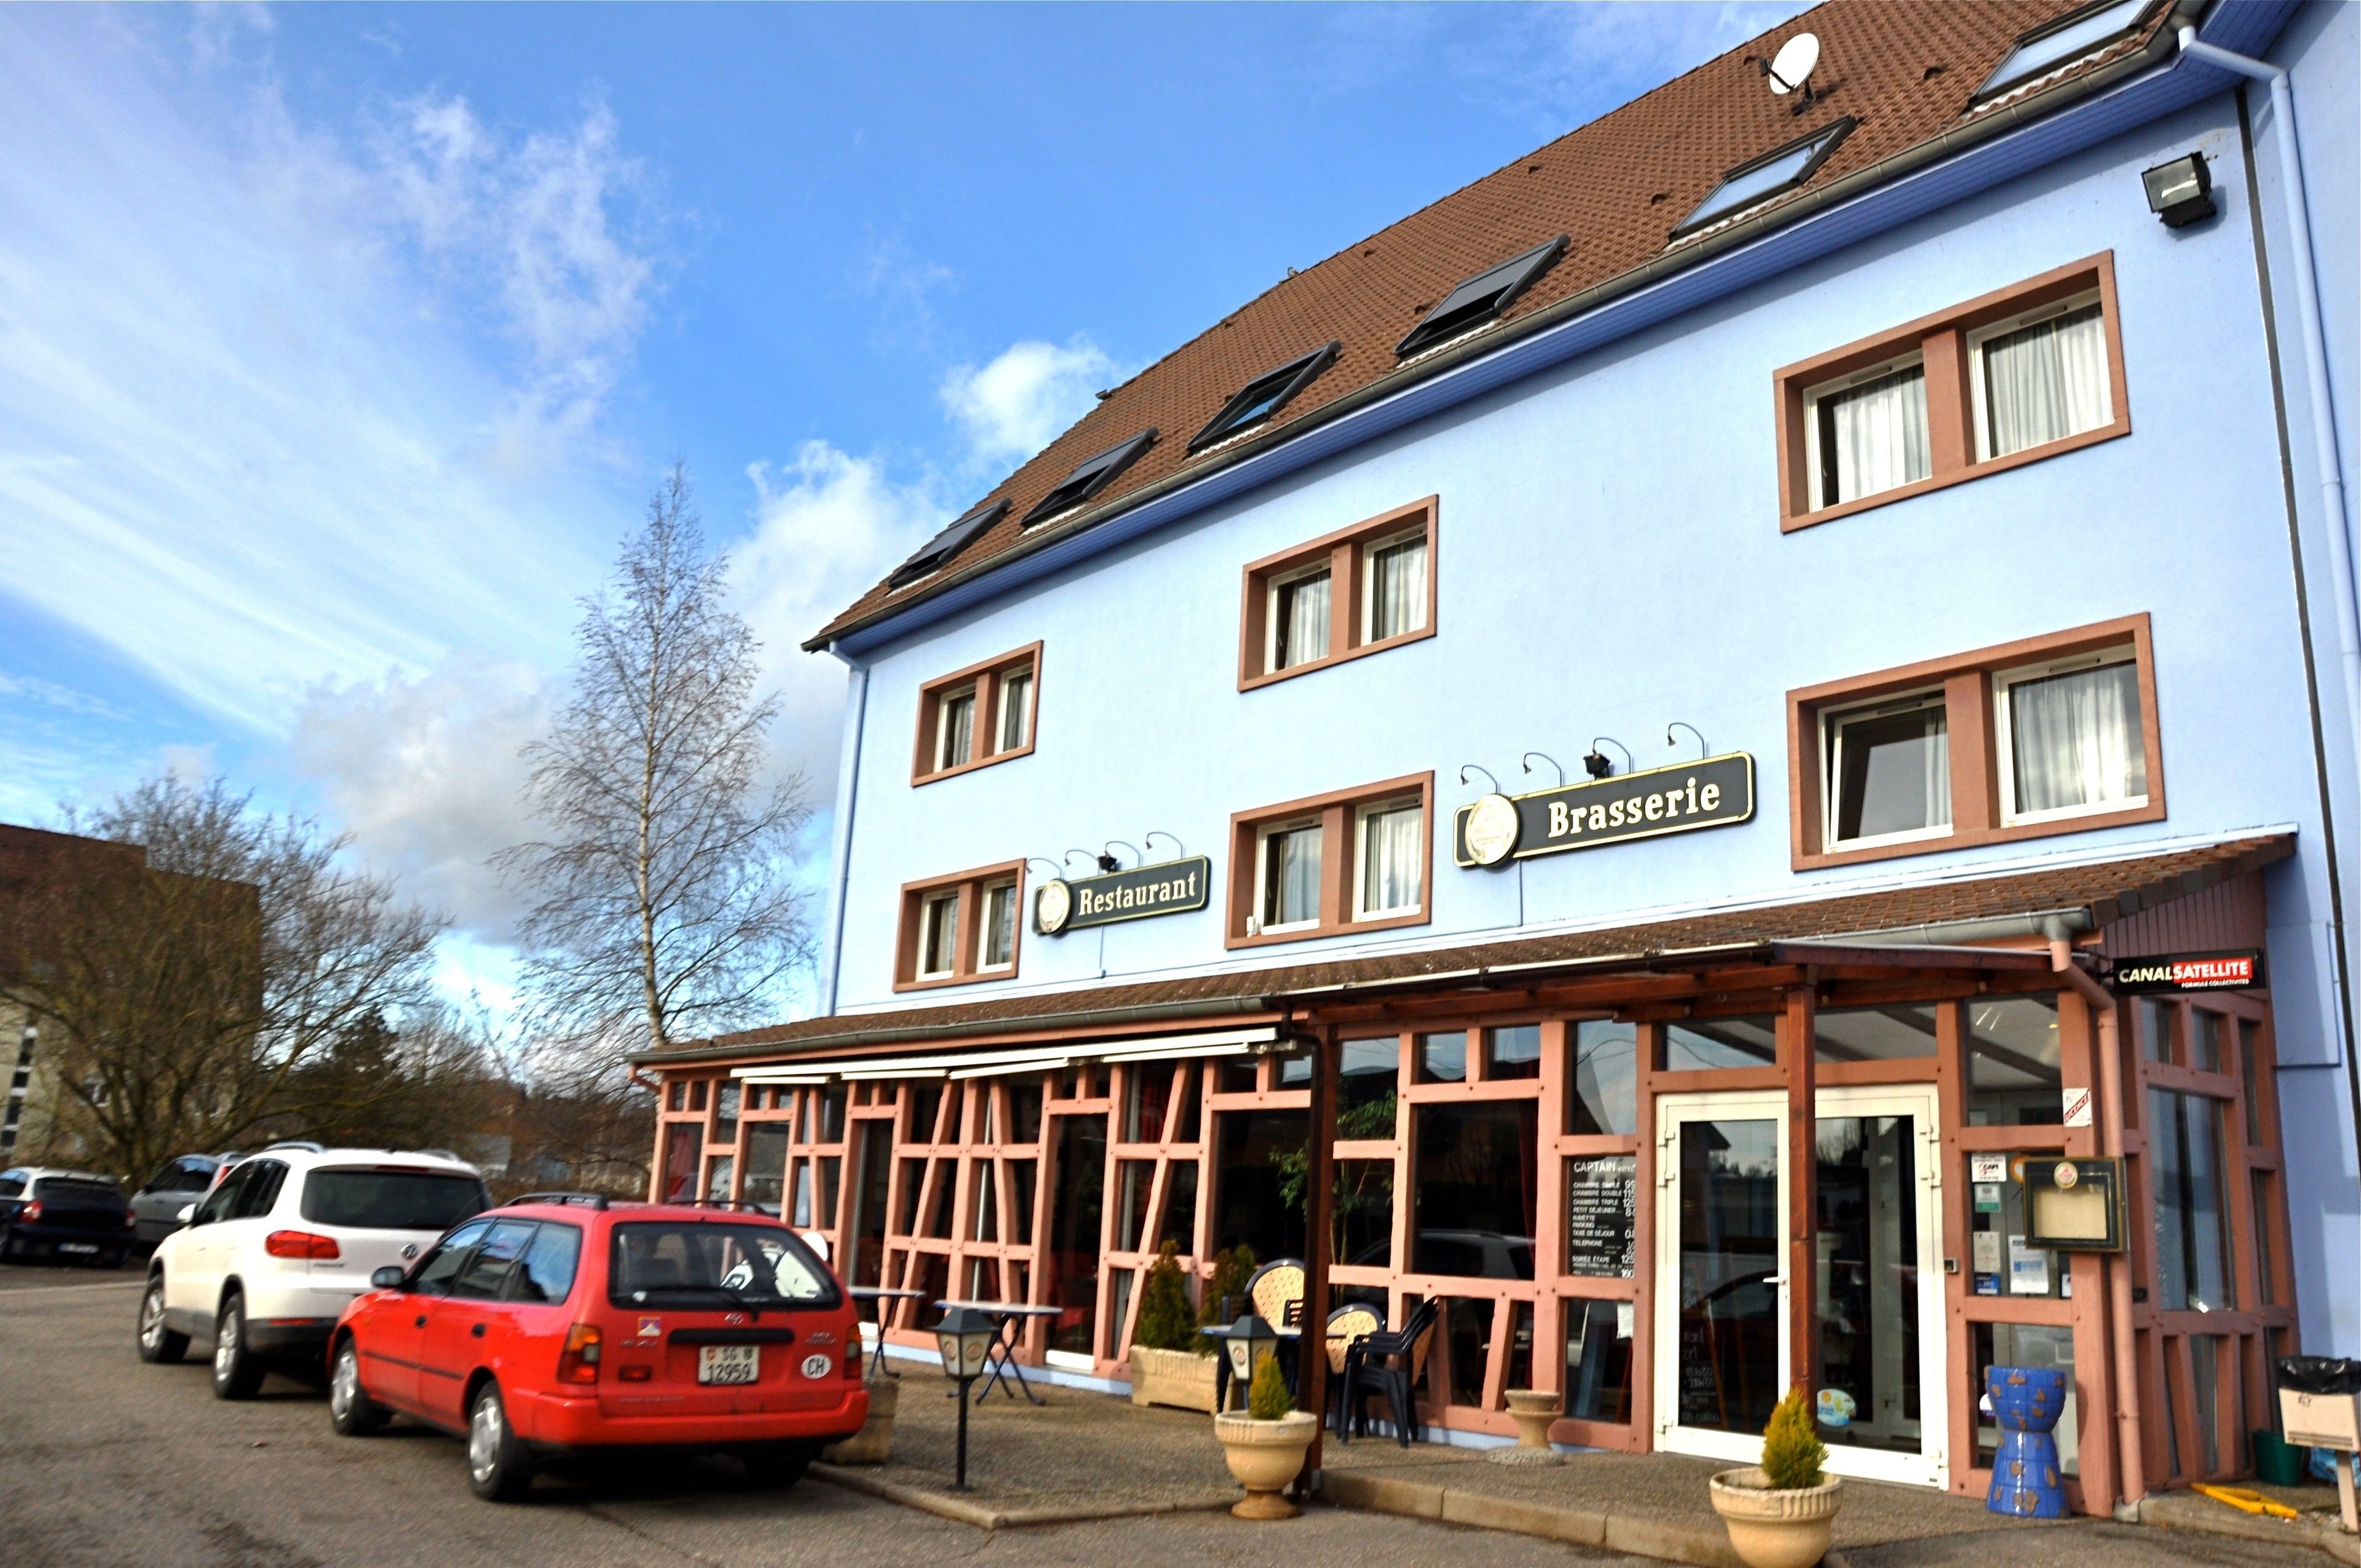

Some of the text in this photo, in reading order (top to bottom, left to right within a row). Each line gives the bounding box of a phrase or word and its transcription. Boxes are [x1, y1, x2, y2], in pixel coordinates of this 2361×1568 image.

[1548, 777, 1720, 838] Brasserie
[1078, 871, 1196, 916] Restaurant
[1574, 1161, 1616, 1173] CAPTAIN
[807, 1357, 826, 1376] CH
